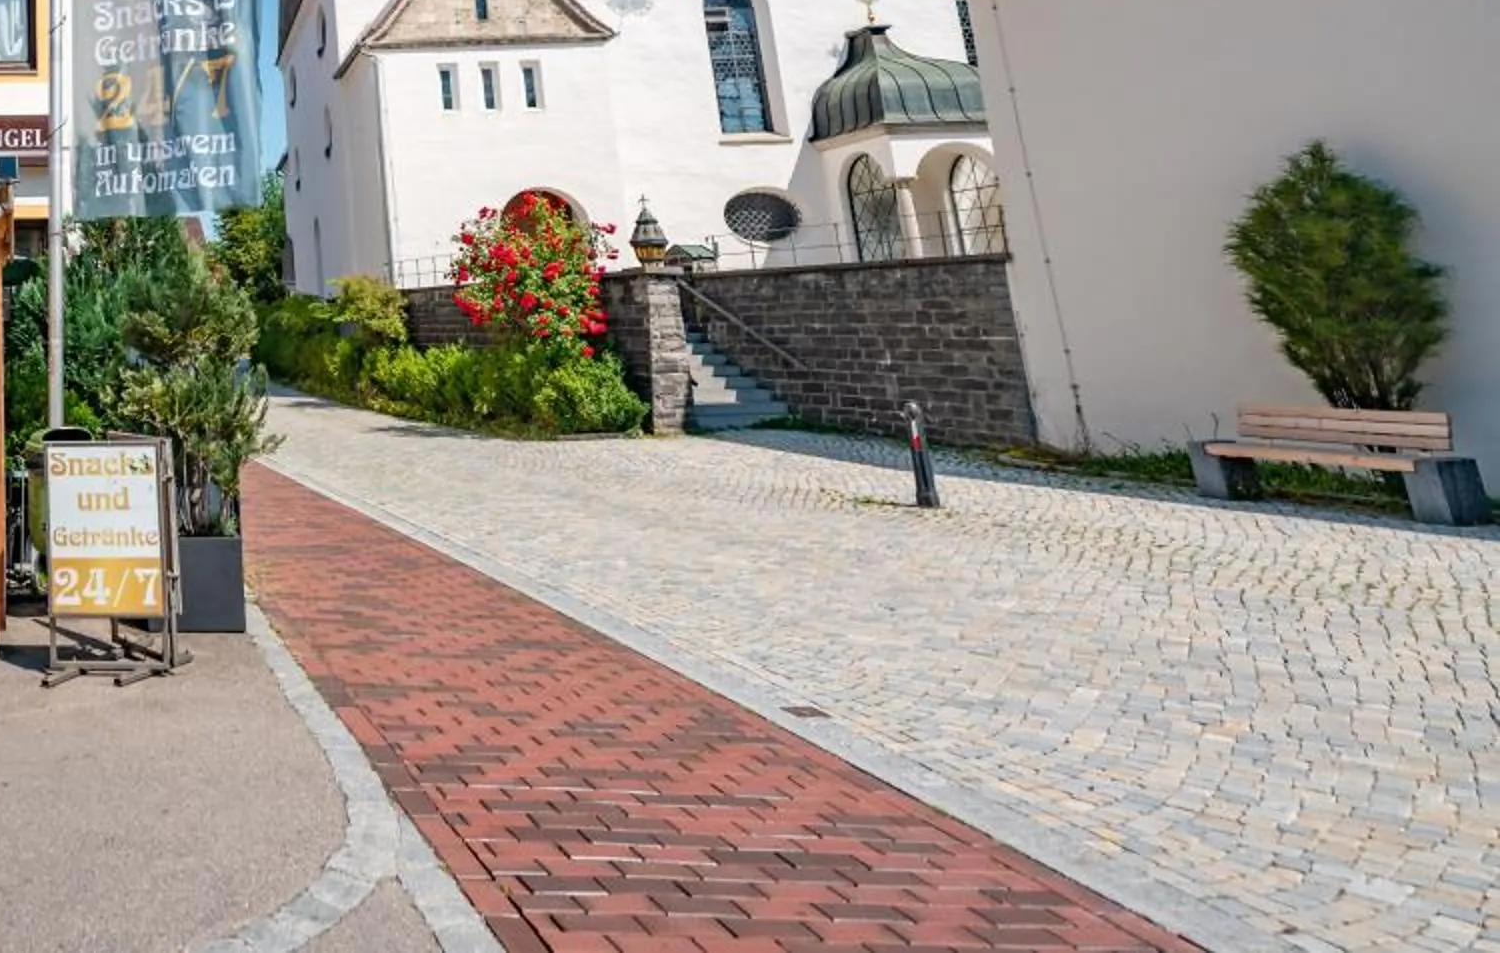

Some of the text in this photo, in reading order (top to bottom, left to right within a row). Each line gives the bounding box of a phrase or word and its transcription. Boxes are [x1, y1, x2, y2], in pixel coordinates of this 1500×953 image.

[94, 21, 237, 66] Getränke
[95, 54, 236, 131] 24/7
[95, 132, 236, 167] in unserem
[95, 163, 236, 197] Automaten
[77, 487, 130, 511] und
[53, 526, 158, 547] Getränke
[55, 567, 160, 608] 24/7
